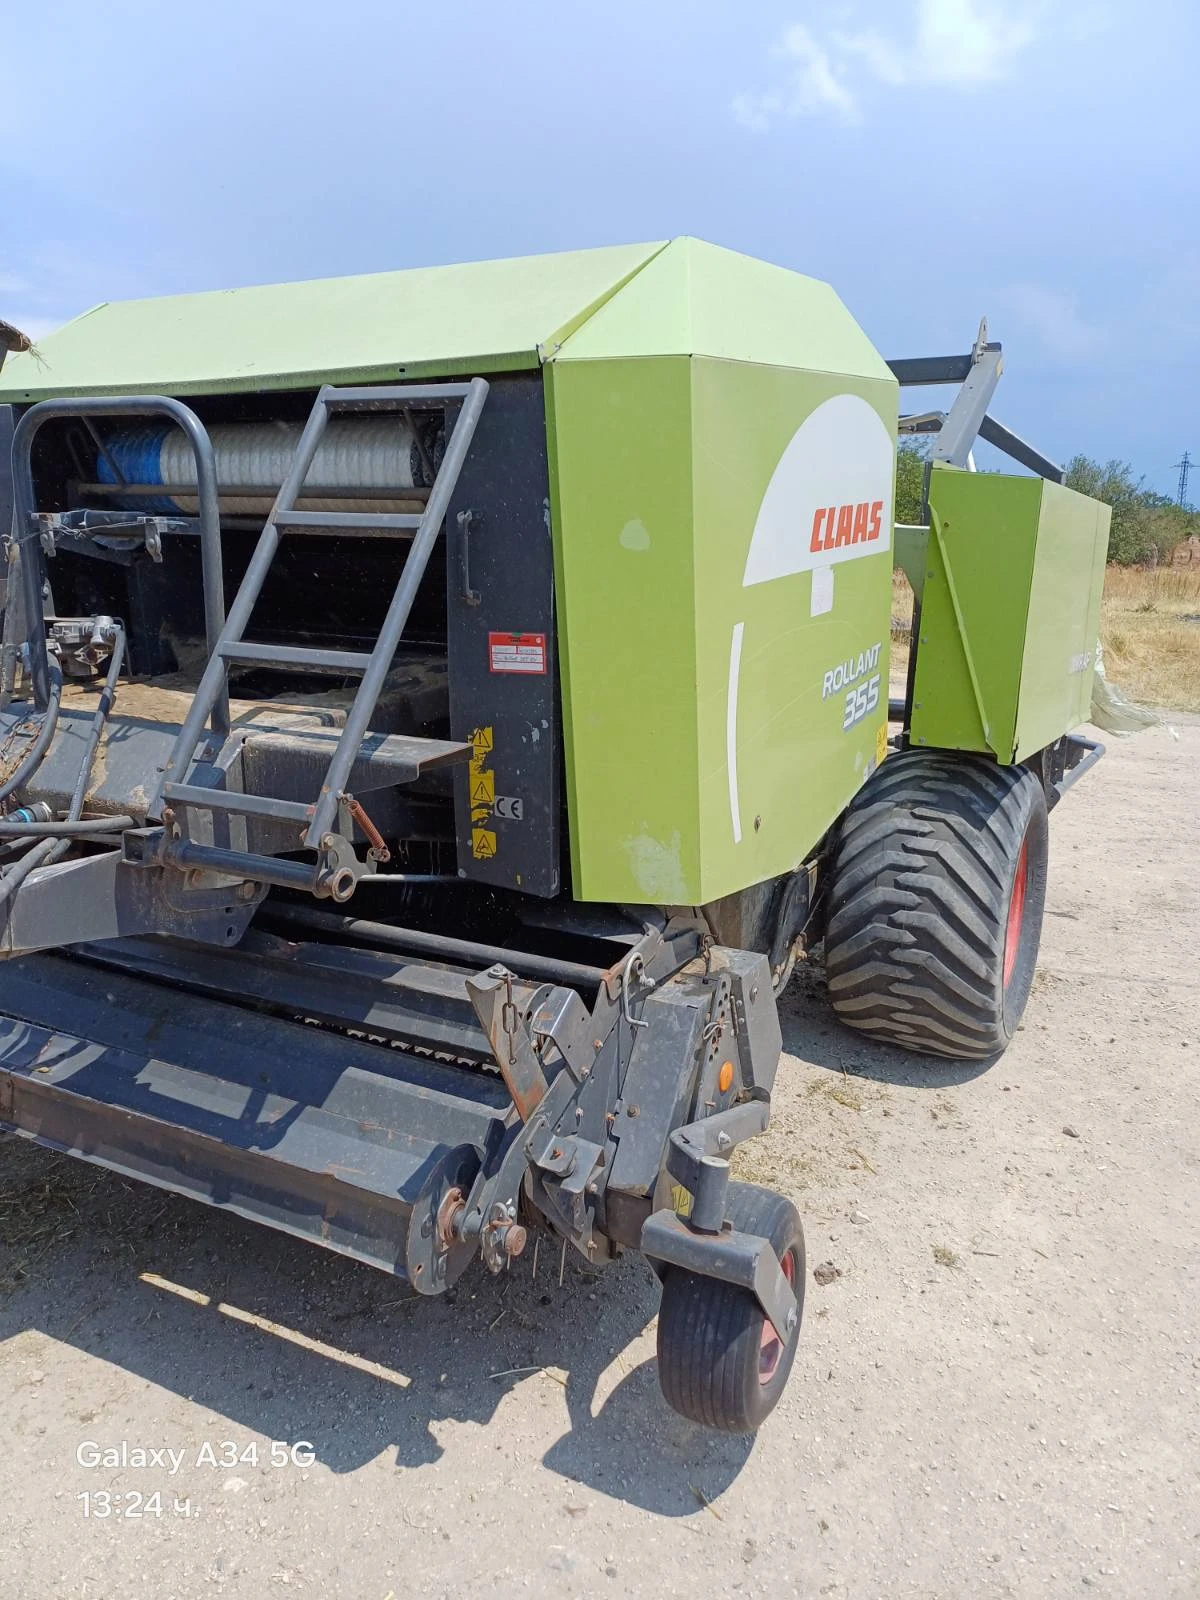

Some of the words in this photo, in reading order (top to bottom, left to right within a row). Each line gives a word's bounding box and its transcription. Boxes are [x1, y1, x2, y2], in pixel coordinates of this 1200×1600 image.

[810, 501, 883, 552] CLAAS
[822, 642, 881, 702] ROLLANT
[842, 674, 880, 734] 355
[496, 797, 521, 819] CE
